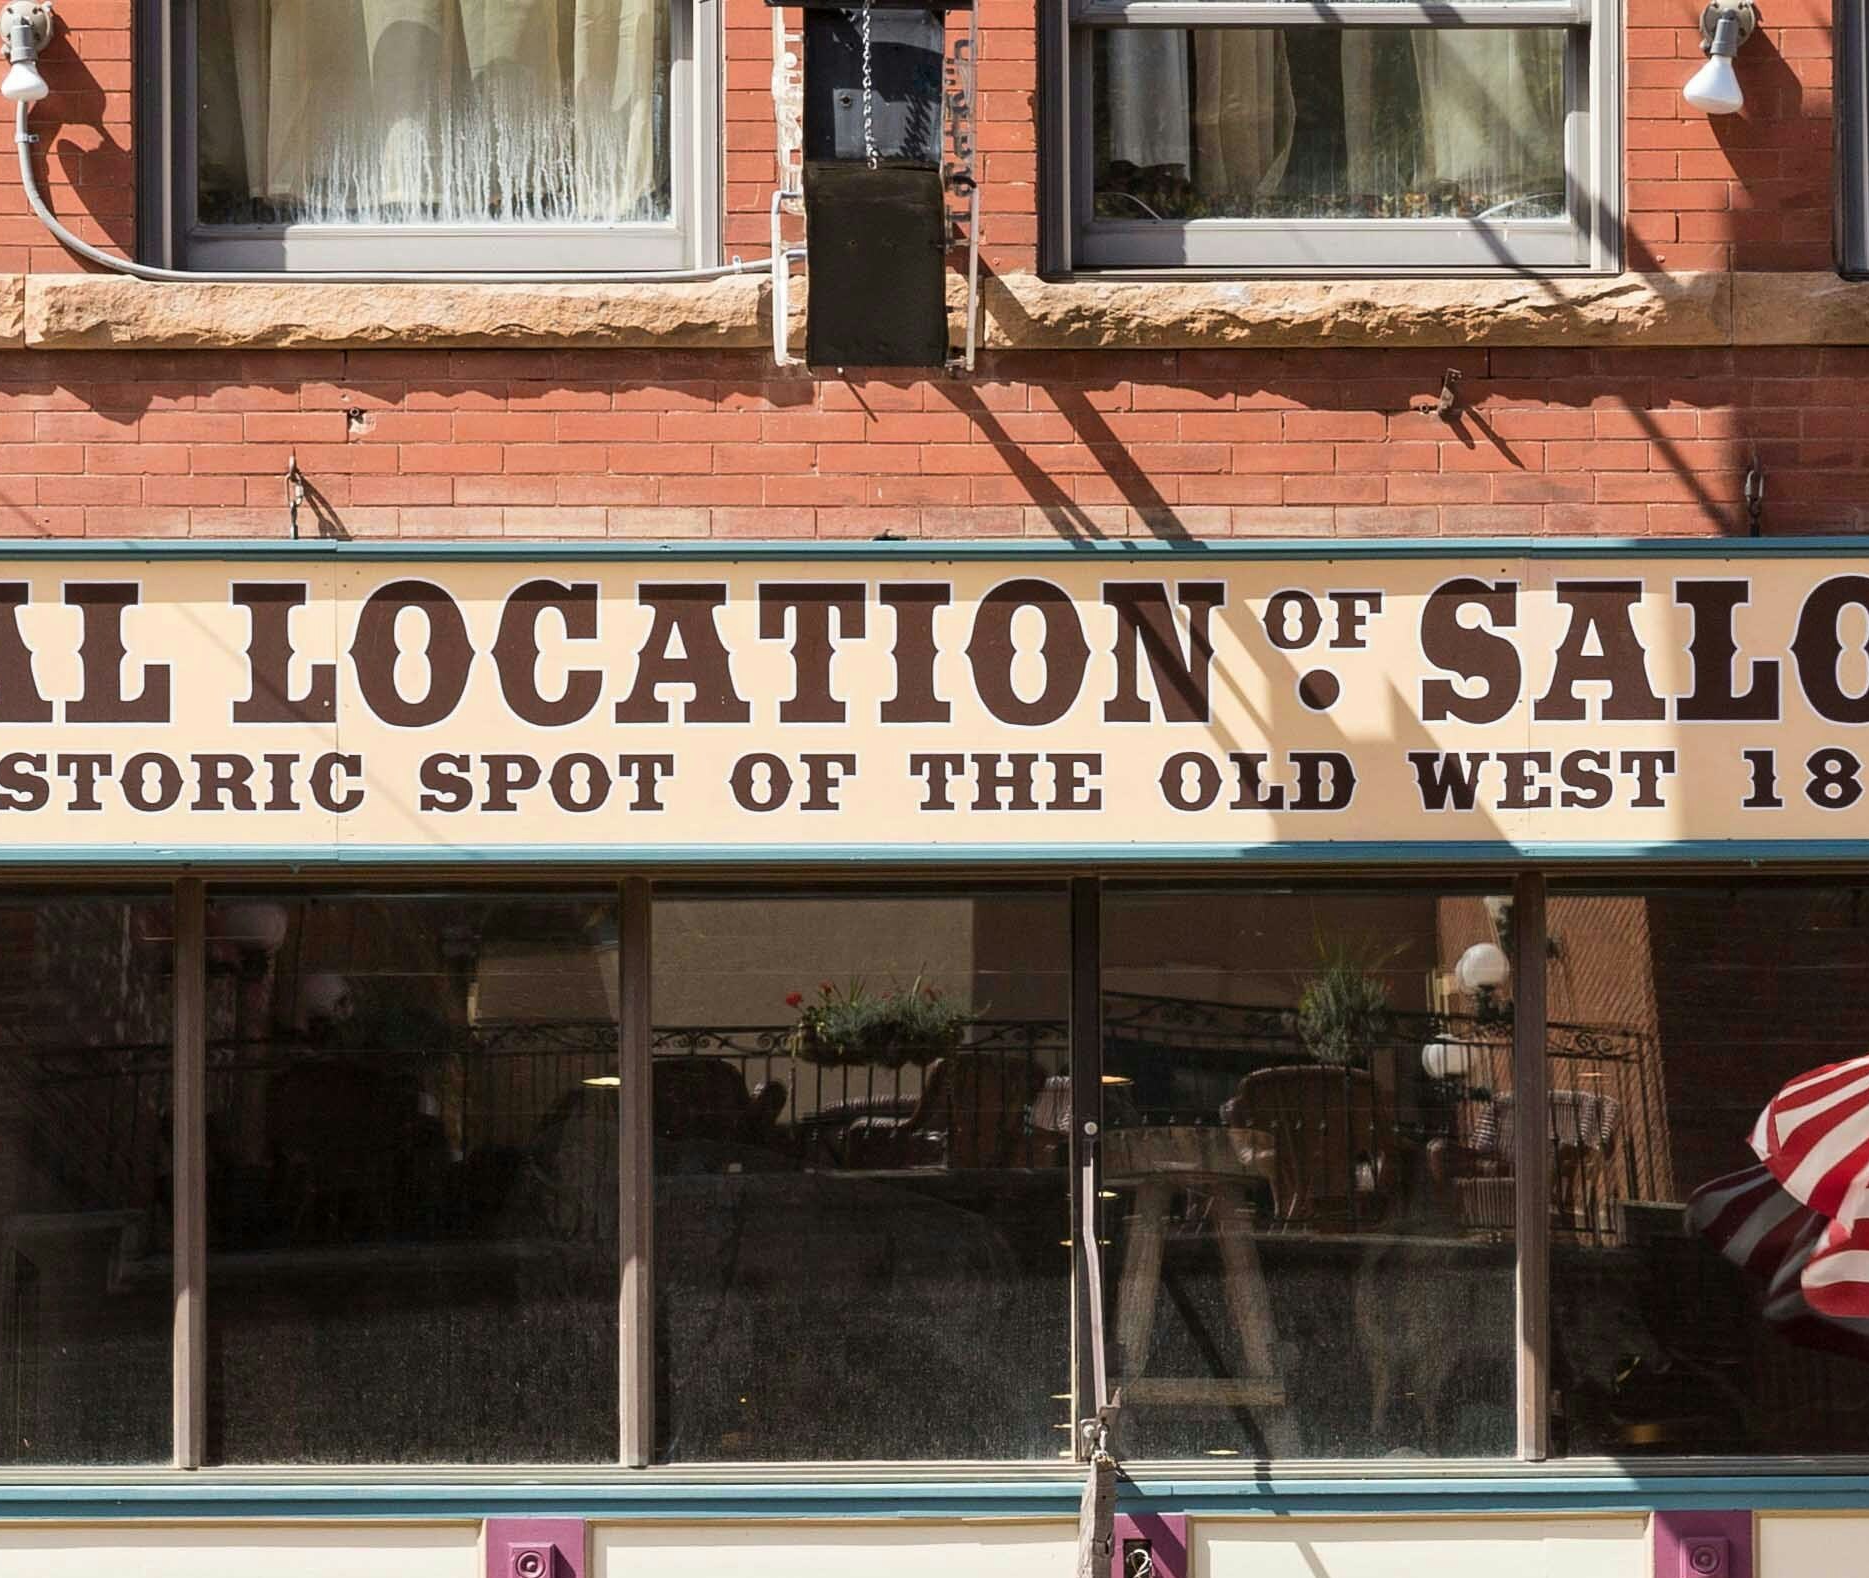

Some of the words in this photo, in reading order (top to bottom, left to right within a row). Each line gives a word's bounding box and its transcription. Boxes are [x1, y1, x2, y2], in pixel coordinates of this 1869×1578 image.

[232, 577, 1226, 728] LOCATION
[1262, 589, 1383, 650] OF
[420, 751, 674, 812] SPOT
[729, 752, 856, 812] OF
[910, 752, 1102, 811] THE
[1159, 751, 1356, 812] OLD
[1408, 749, 1675, 810] WEST
